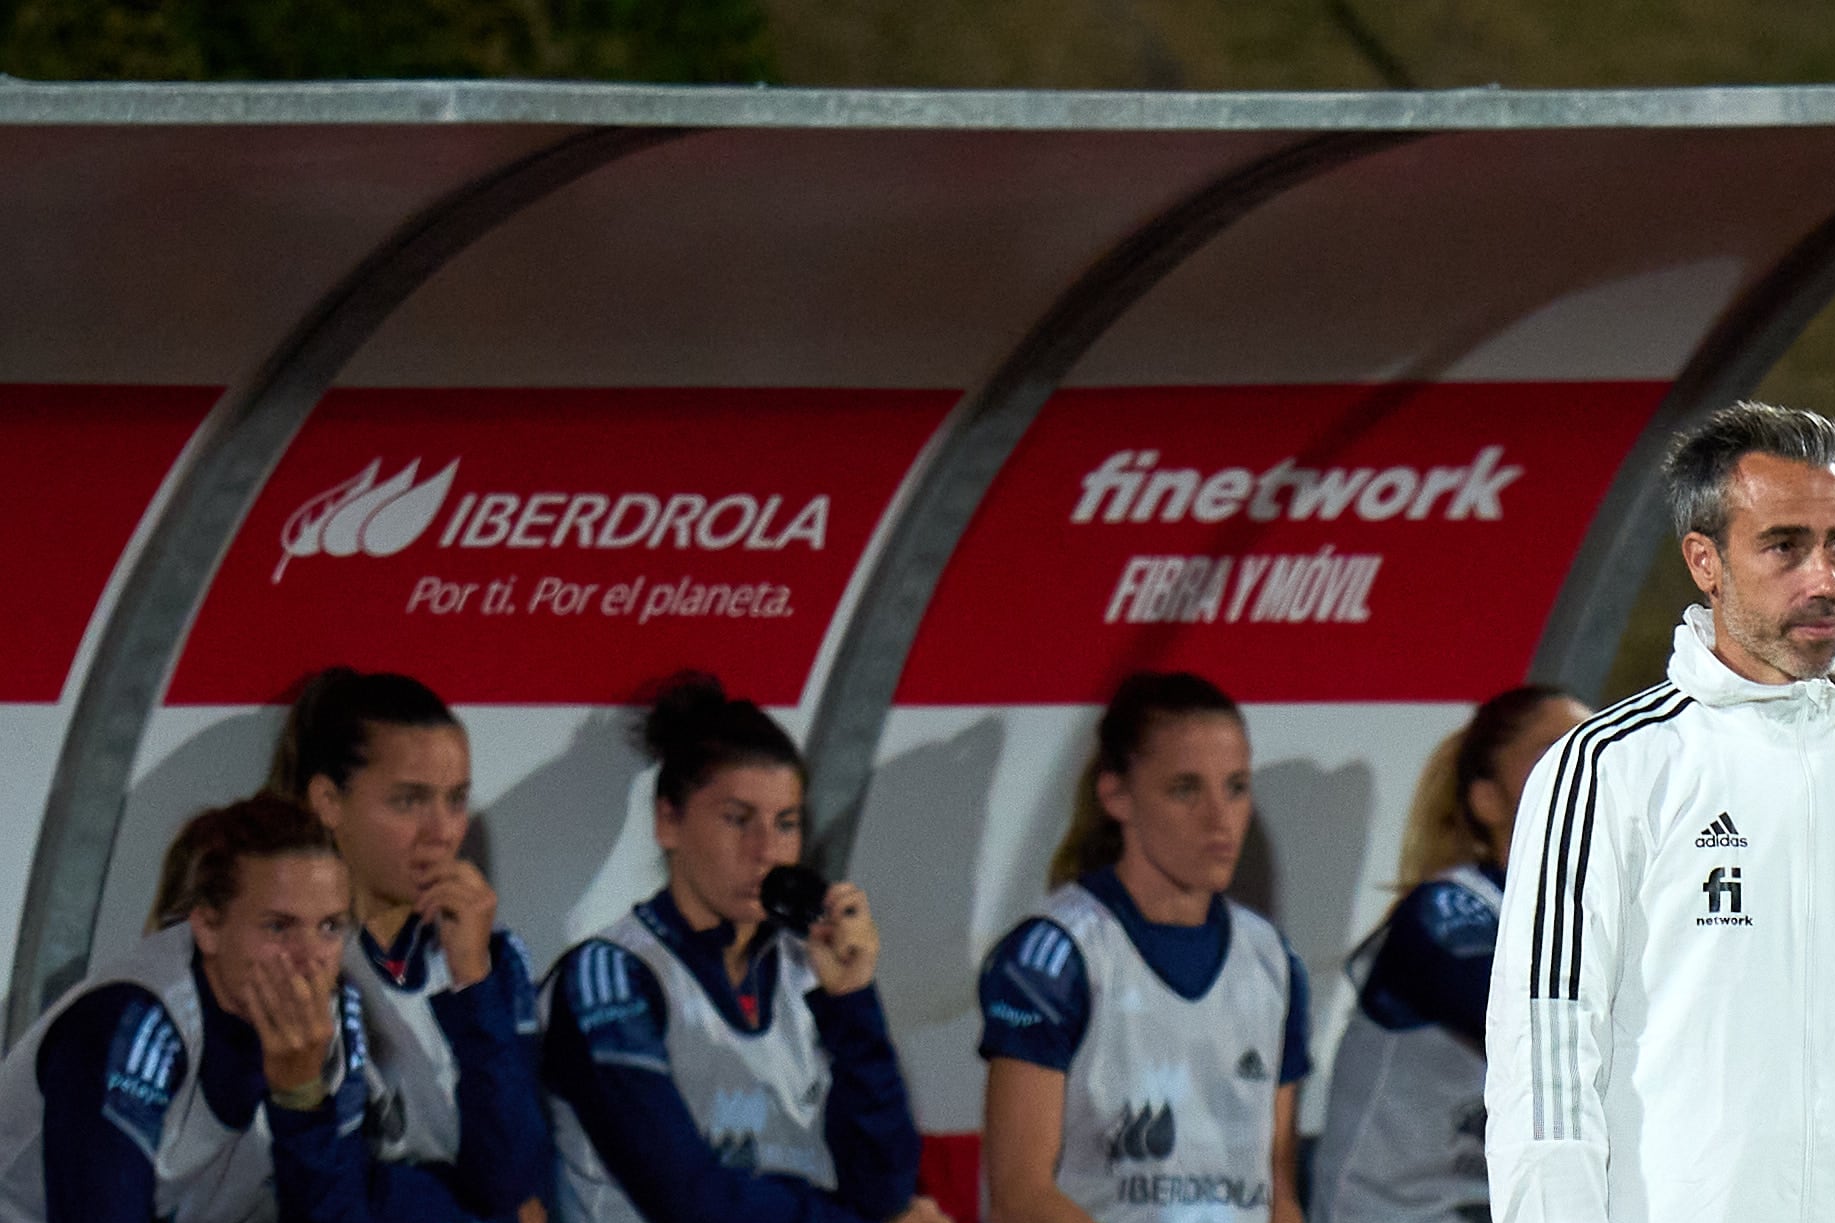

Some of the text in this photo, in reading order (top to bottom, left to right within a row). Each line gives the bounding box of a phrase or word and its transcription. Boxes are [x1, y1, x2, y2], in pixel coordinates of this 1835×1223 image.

[1069, 446, 1525, 523] finetwork
[438, 493, 830, 551] IBERDROLA
[405, 574, 794, 625] Por ti. Por el planeta.
[1104, 543, 1384, 624] FIBRA Y MÓVIL
[1695, 834, 1748, 848] adidas
[1703, 867, 1742, 913] fi
[1696, 915, 1753, 926] network
